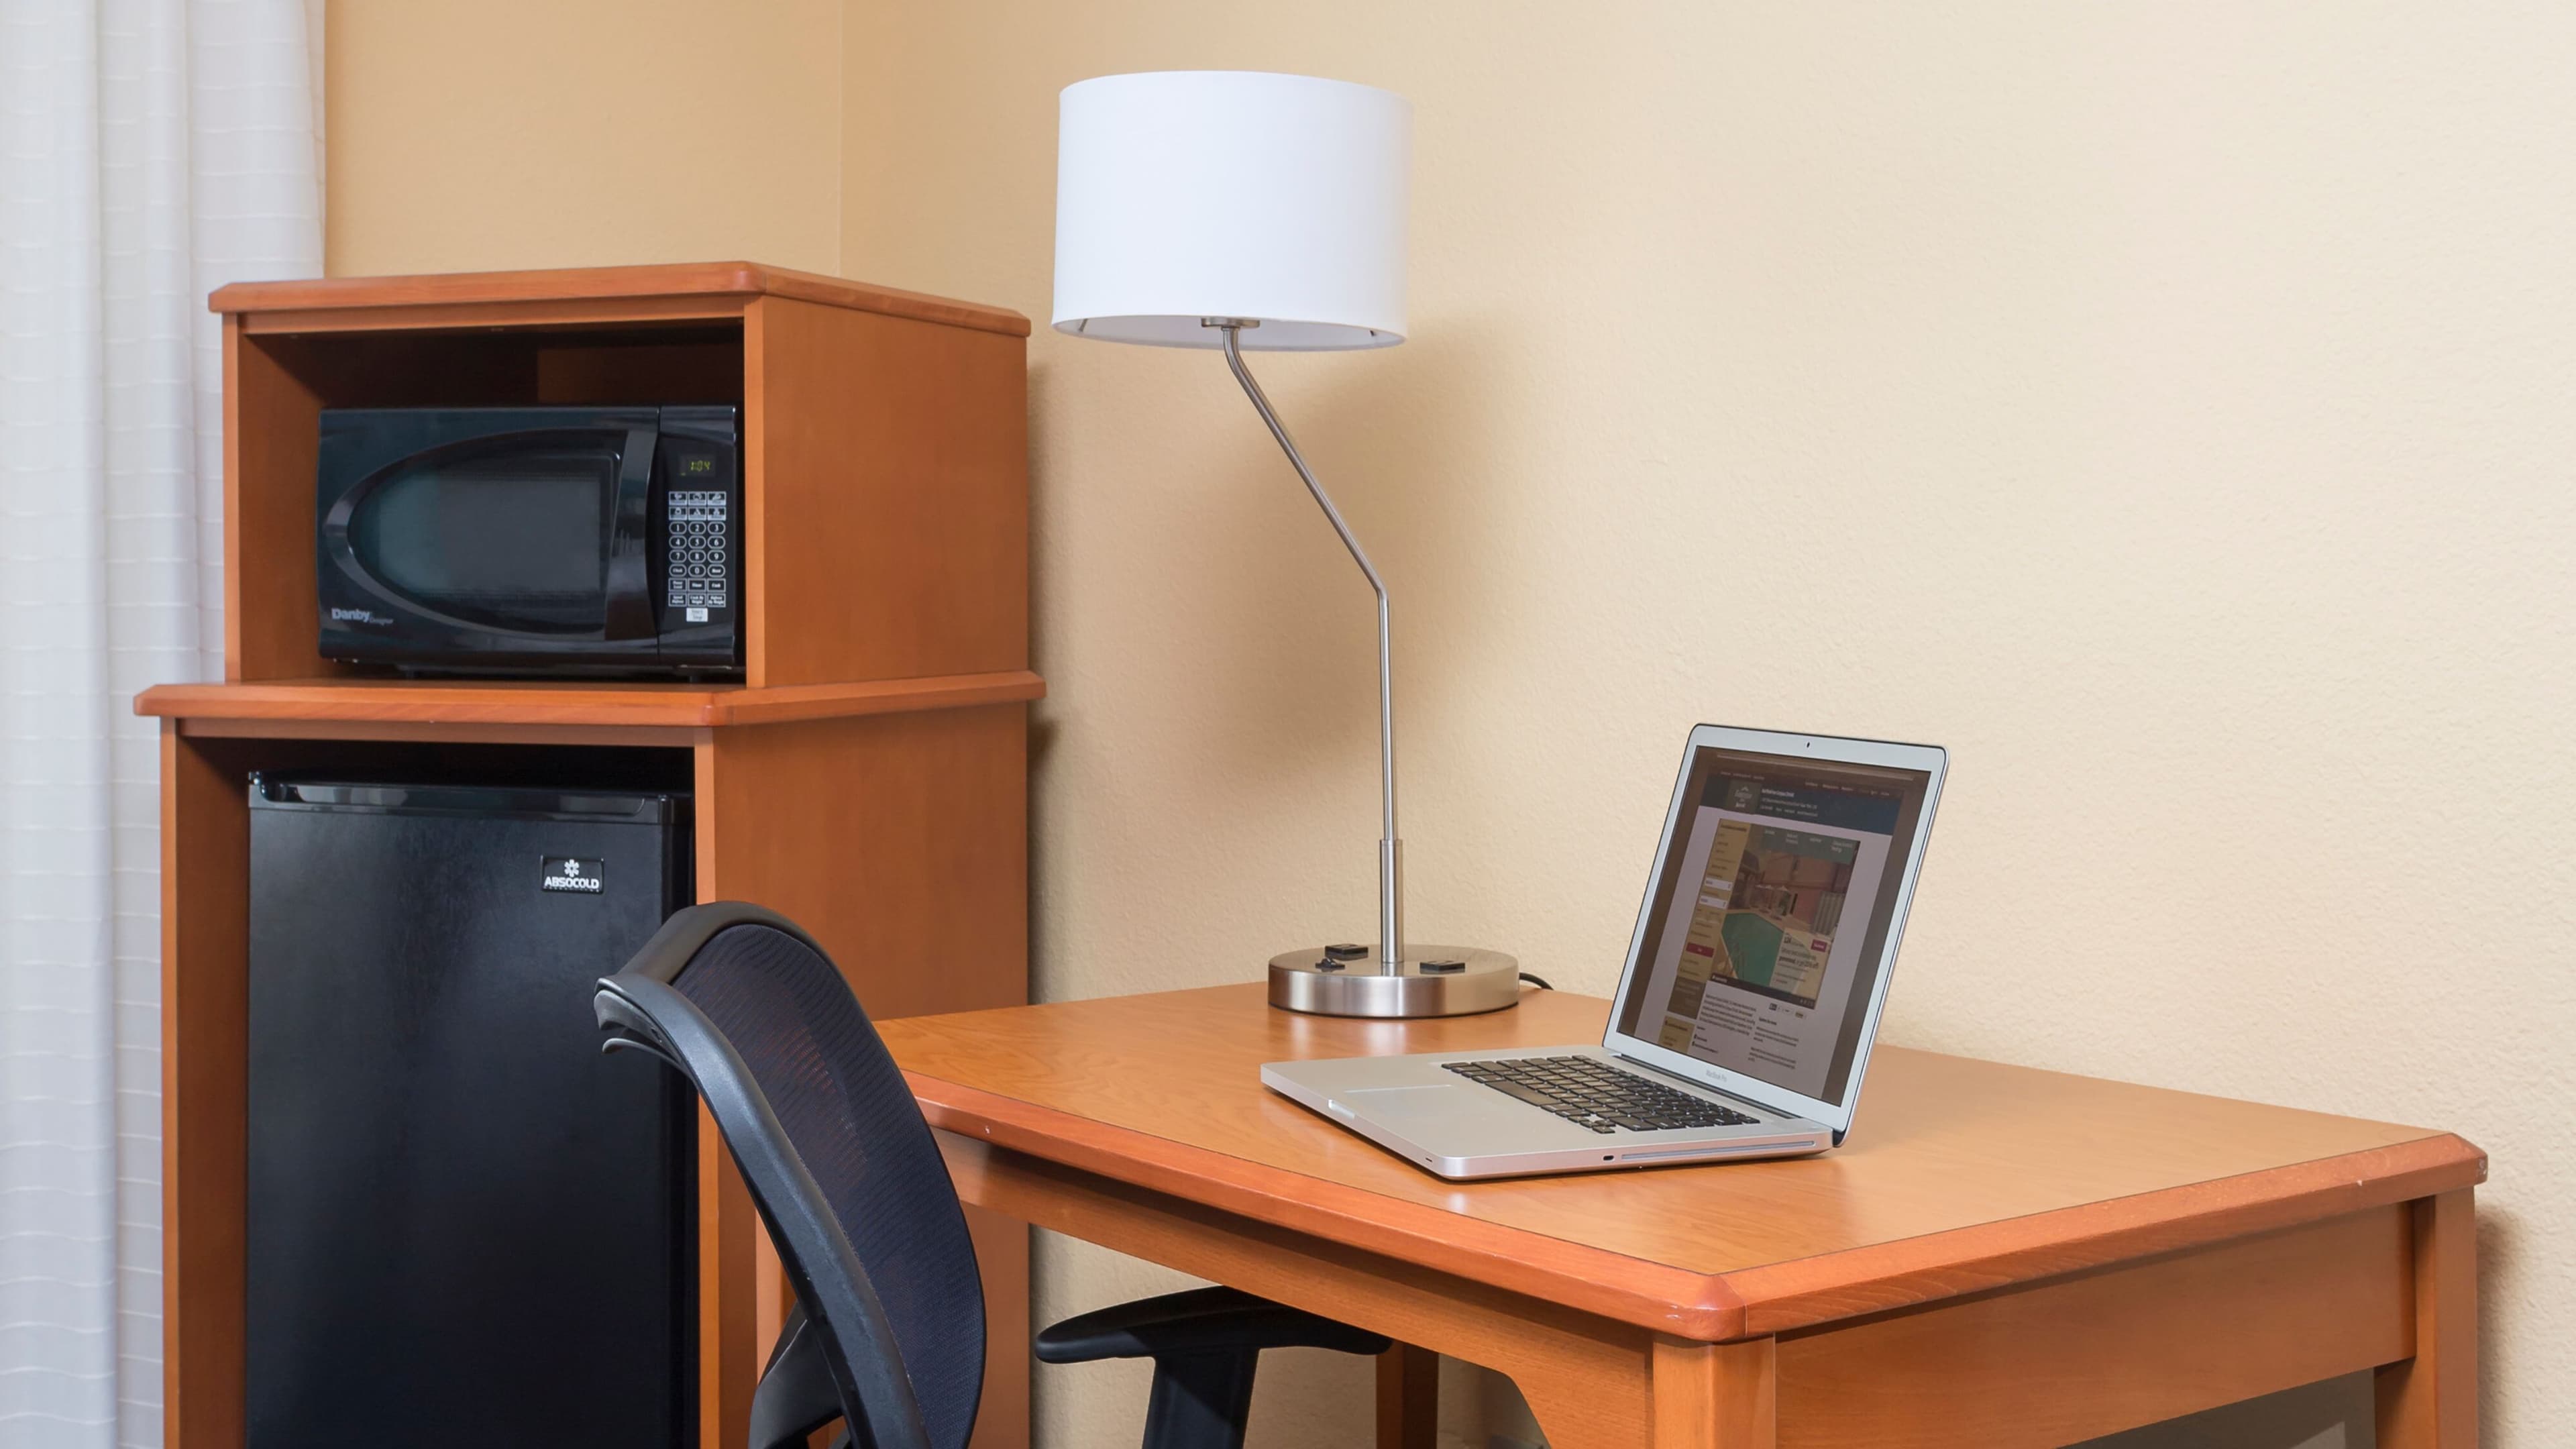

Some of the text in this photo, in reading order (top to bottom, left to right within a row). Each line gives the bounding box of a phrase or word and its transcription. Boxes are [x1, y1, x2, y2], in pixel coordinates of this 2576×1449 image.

[690, 460, 710, 472] 1:04
[331, 607, 370, 623] Danby
[544, 876, 600, 889] ABSOCOLD
